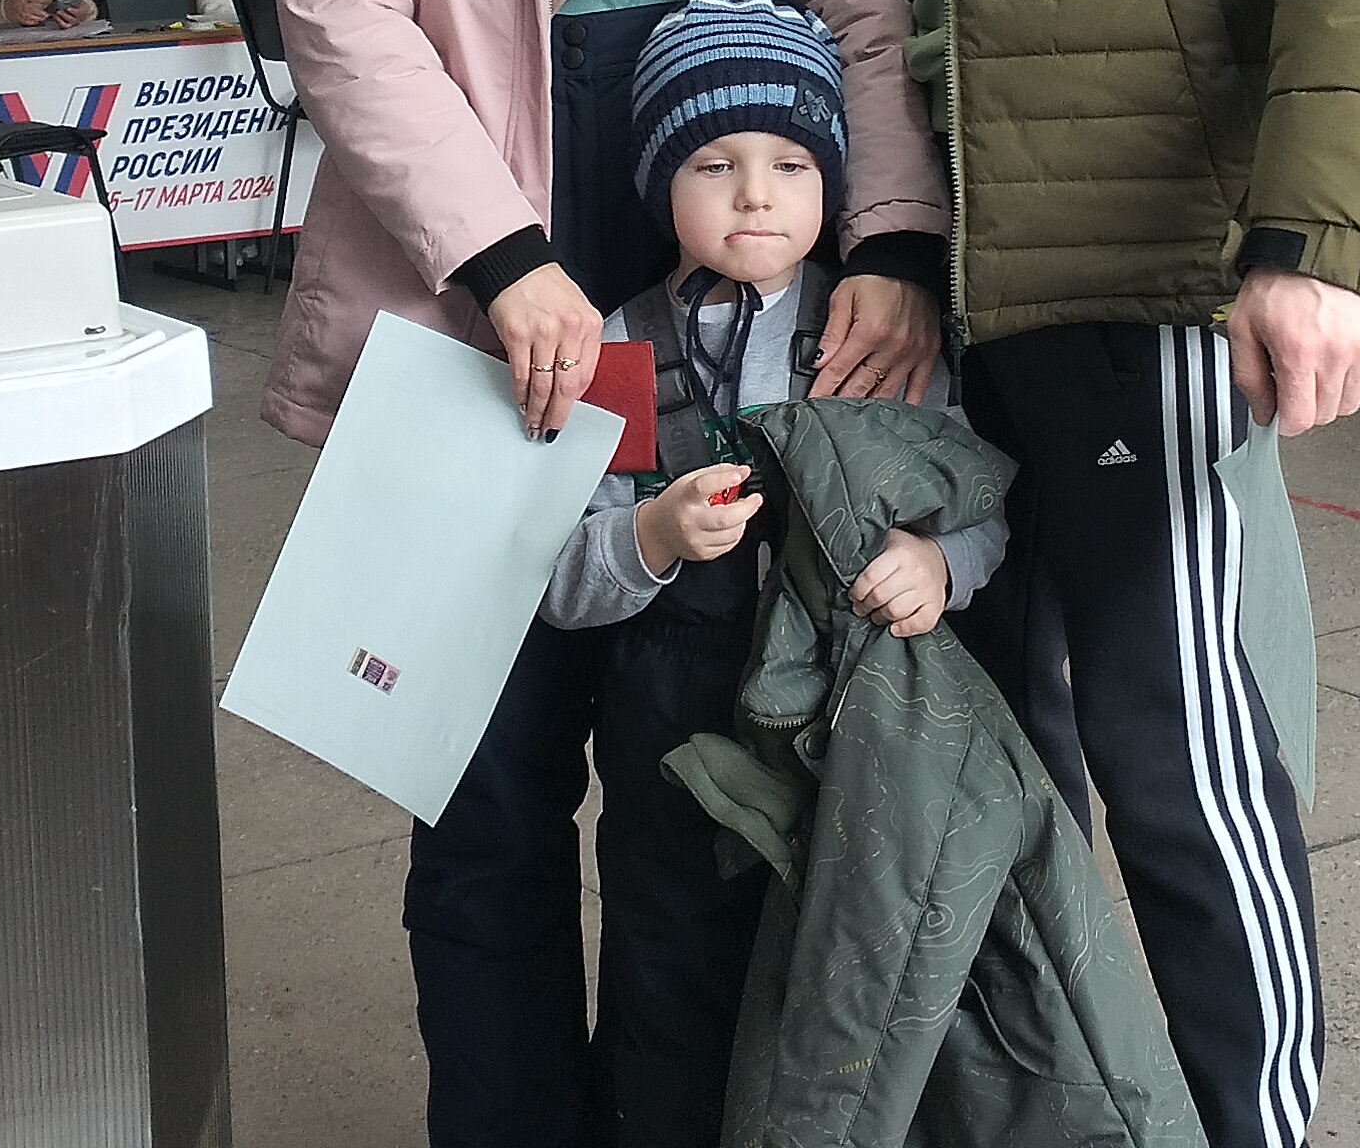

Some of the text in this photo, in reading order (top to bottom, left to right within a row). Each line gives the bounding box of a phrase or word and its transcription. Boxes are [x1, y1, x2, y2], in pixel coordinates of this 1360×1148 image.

[134, 72, 258, 108] ВЫБОРЫ
[108, 146, 223, 182] РОССИИ
[156, 180, 225, 209] МАРТА
[228, 175, 276, 201] 2024
[1097, 454, 1138, 466] adidas
